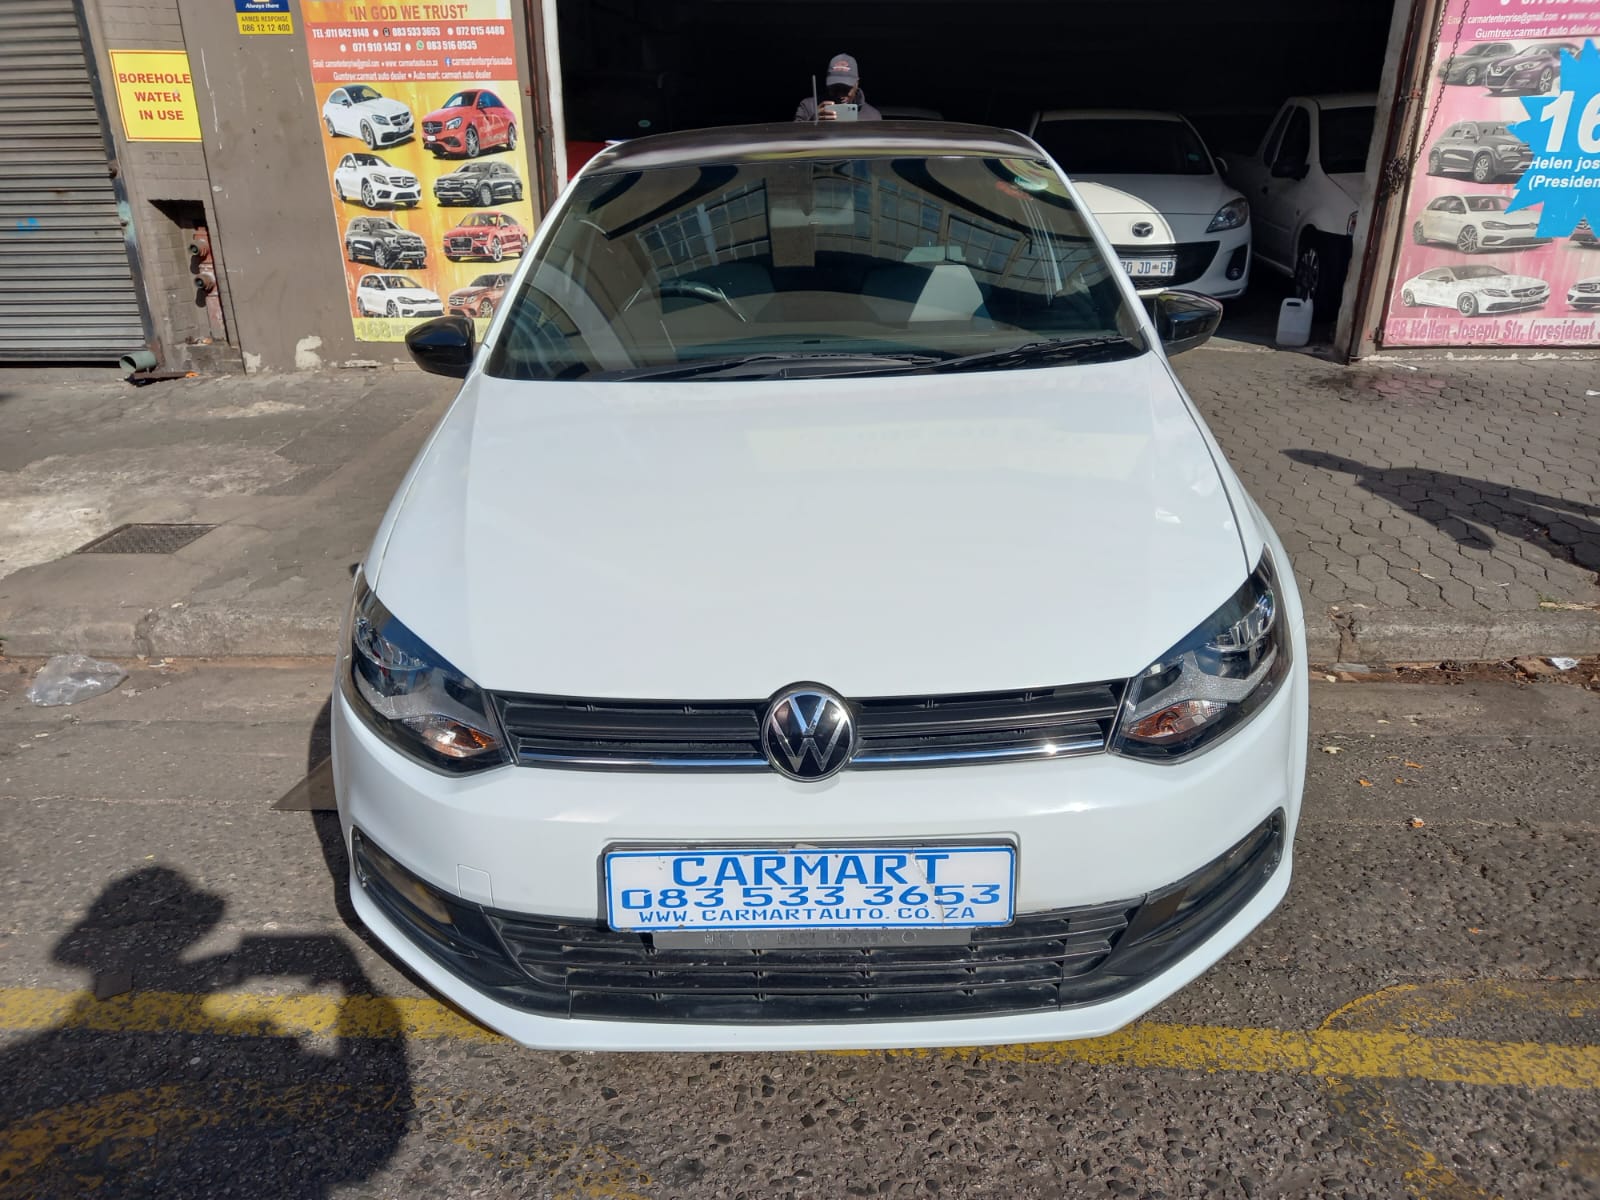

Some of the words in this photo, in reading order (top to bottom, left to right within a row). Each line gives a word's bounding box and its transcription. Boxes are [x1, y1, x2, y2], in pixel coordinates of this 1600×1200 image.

[371, 6, 397, 20] GOD
[400, 5, 420, 19] WE
[242, 23, 255, 32] 086
[257, 23, 265, 32] 12
[267, 23, 275, 32] 12
[277, 23, 290, 32] 400
[1548, 26, 1569, 36] auto
[119, 73, 191, 84] BOREHOLE
[134, 91, 182, 102] WATER
[139, 110, 154, 120] IN
[157, 110, 185, 121] USE
[1529, 157, 1572, 170] Helen
[1138, 261, 1152, 274] JD
[1160, 261, 1173, 274] GP
[1453, 319, 1500, 342] Joseph
[1503, 319, 1526, 340] Str.
[672, 854, 949, 887] CARMART
[621, 887, 724, 910] 083
[743, 886, 846, 908] 533
[863, 883, 1001, 907] 3653
